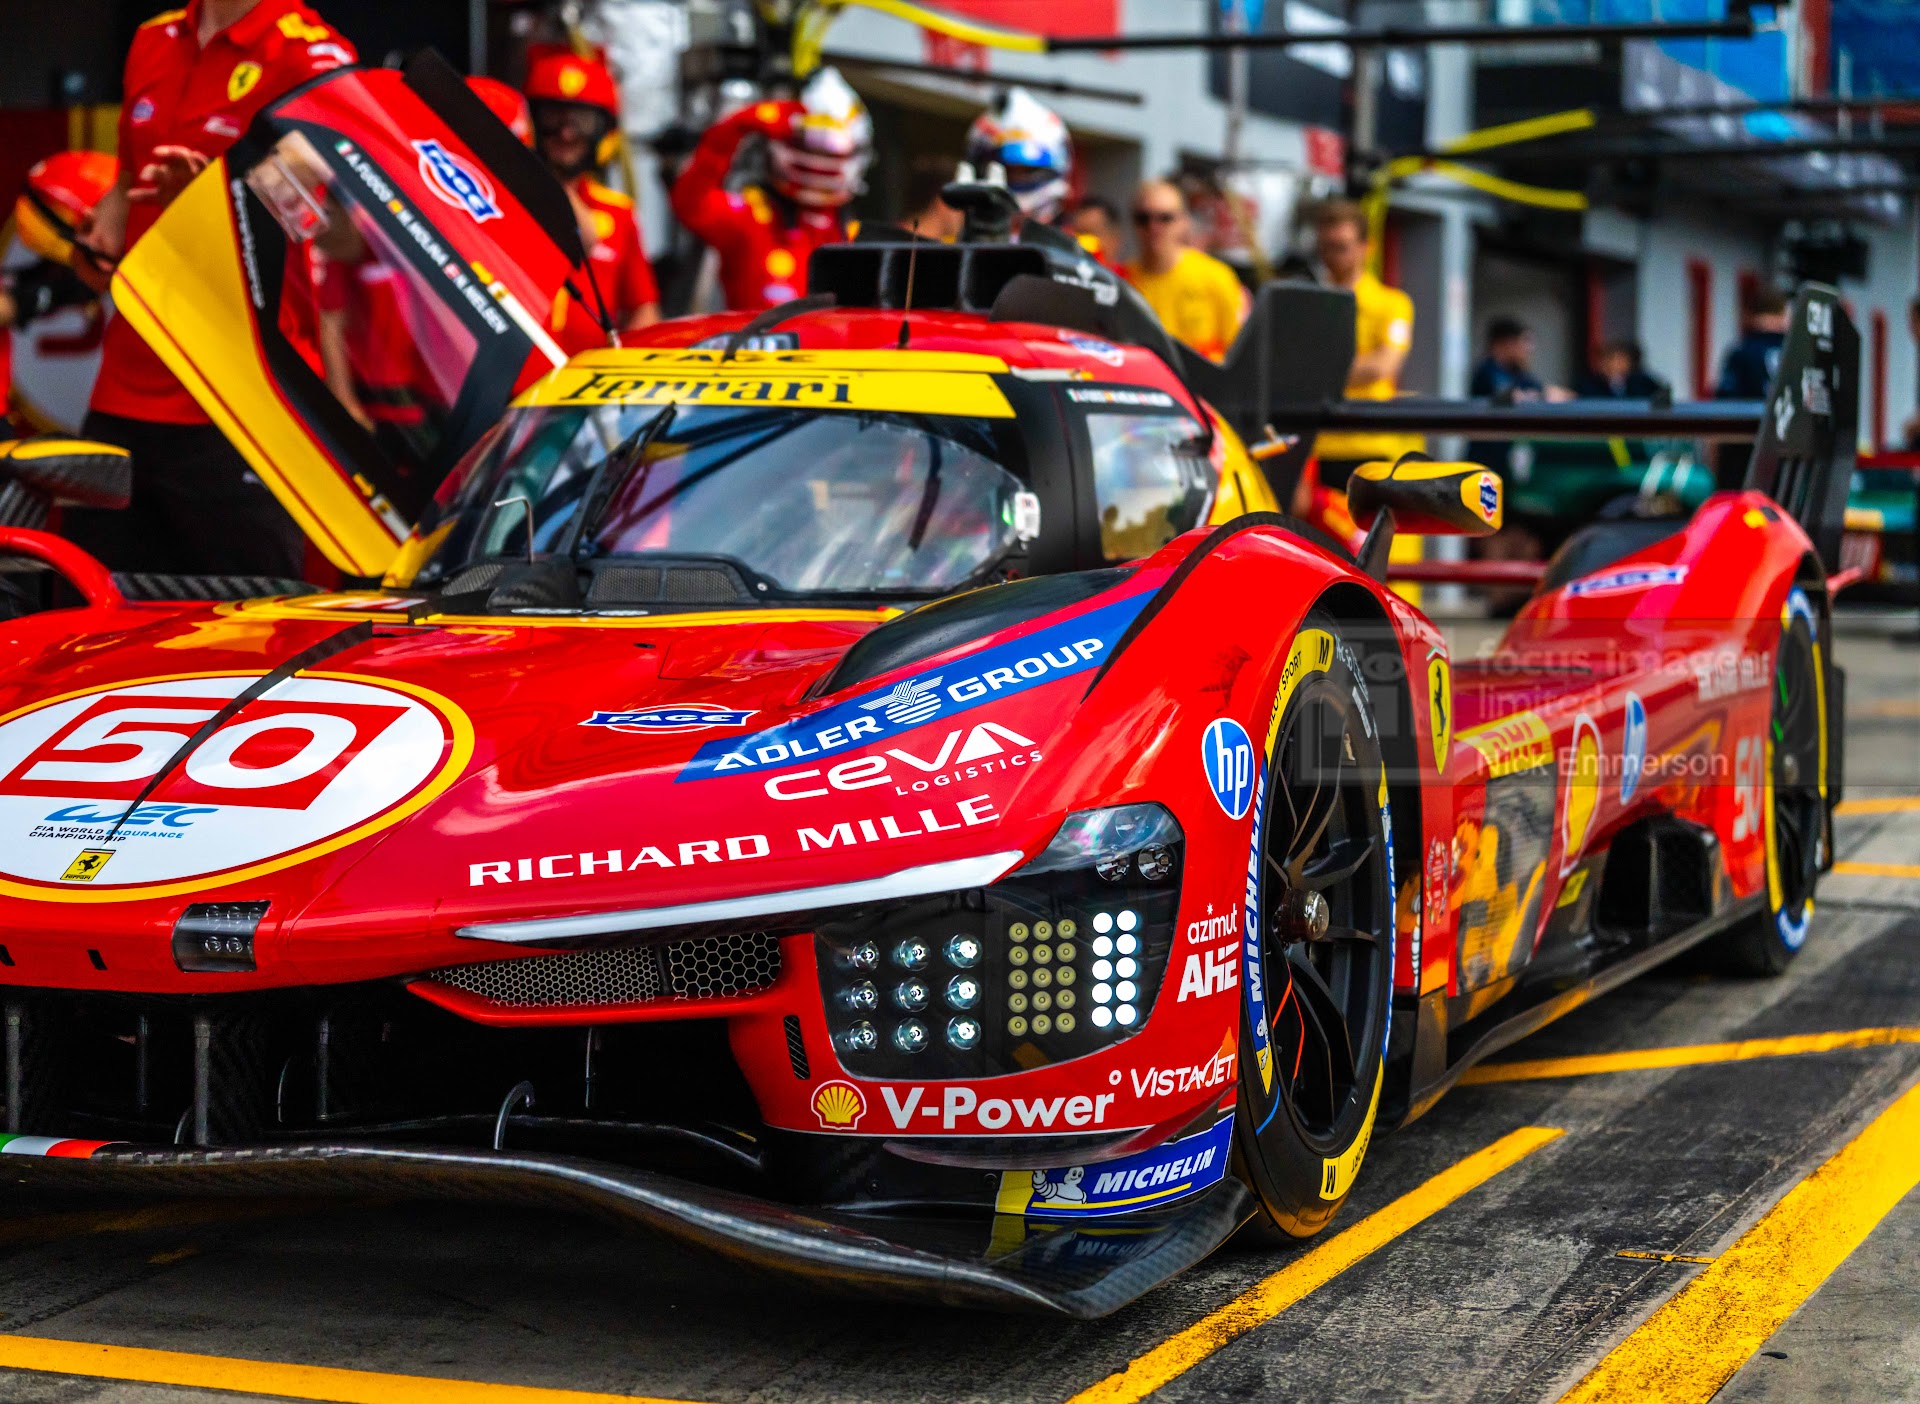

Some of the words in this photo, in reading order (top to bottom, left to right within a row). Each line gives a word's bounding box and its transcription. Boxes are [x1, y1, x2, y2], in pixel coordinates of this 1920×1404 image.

[559, 372, 853, 404] Ferrari
[1281, 651, 1302, 690] SPORT
[1318, 636, 1330, 666] M
[713, 715, 884, 771] ADLER
[947, 638, 1104, 703] GROUP
[20, 708, 357, 788] 50
[1214, 719, 1249, 817] hp
[895, 750, 1043, 797] LOGISTICS
[1733, 736, 1764, 843] 50
[44, 804, 219, 827] WEC
[59, 826, 104, 834] WORLD
[106, 829, 184, 839] ENDURANCE
[469, 834, 770, 887] RICHARD
[798, 794, 1001, 852] MILLE
[1245, 774, 1265, 1002] MICHELIN
[1187, 903, 1238, 945] azimut
[1177, 941, 1240, 1003] AHE
[880, 1086, 1115, 1131] V-Power
[1092, 1146, 1217, 1195] MICHELIN
